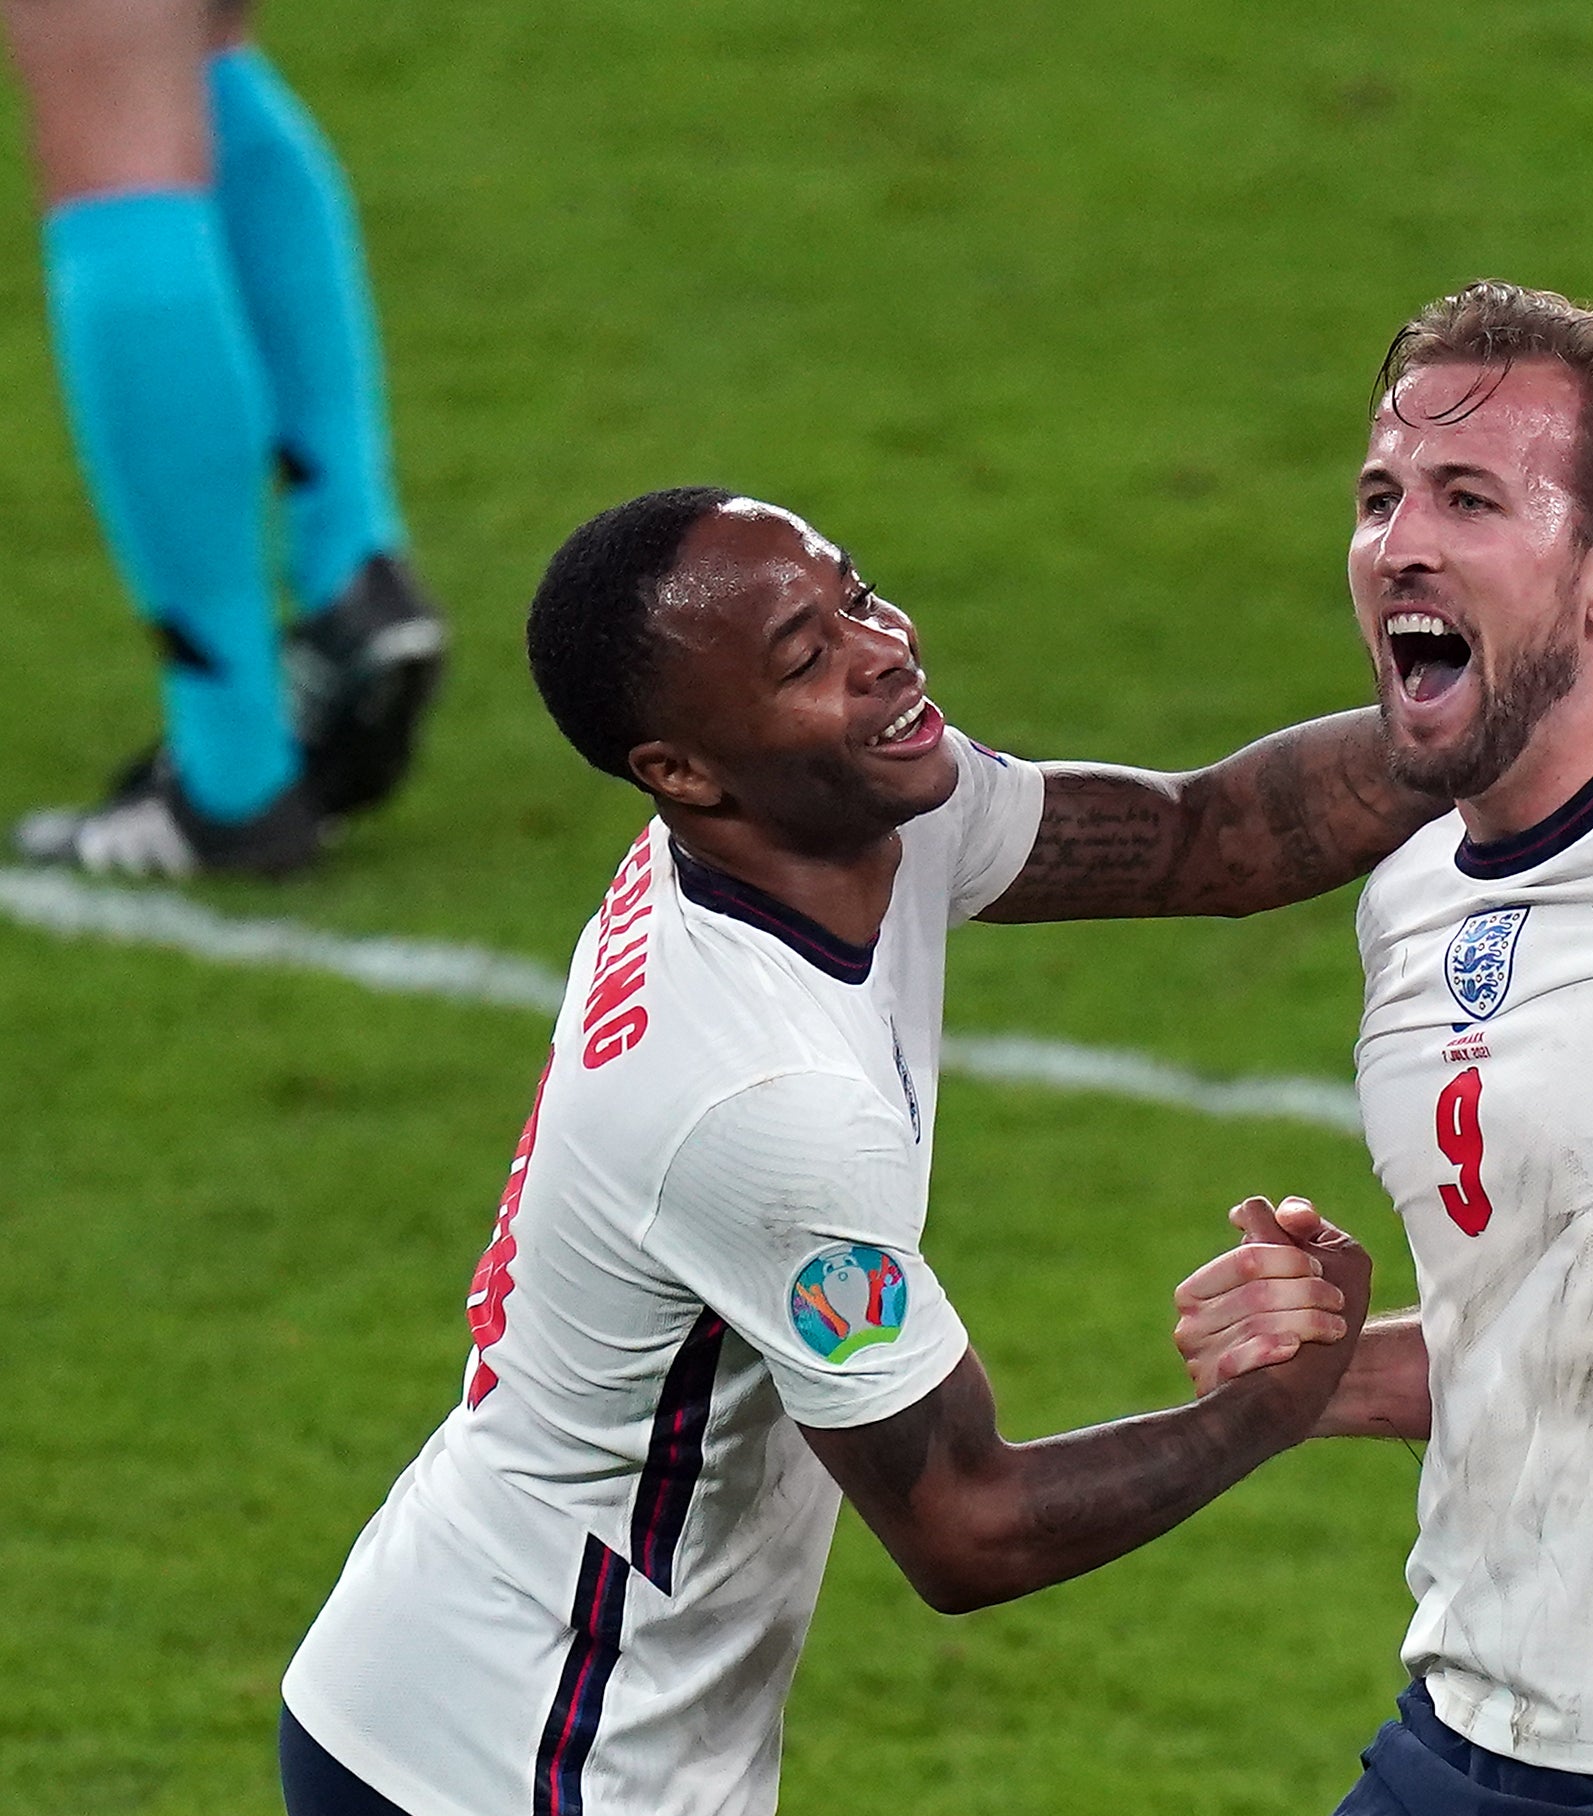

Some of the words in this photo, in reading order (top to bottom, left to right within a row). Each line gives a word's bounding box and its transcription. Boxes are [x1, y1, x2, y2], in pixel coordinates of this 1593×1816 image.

[1450, 1048, 1471, 1062] JULY
[1471, 1046, 1491, 1060] 2021
[1435, 1066, 1493, 1238] 9
